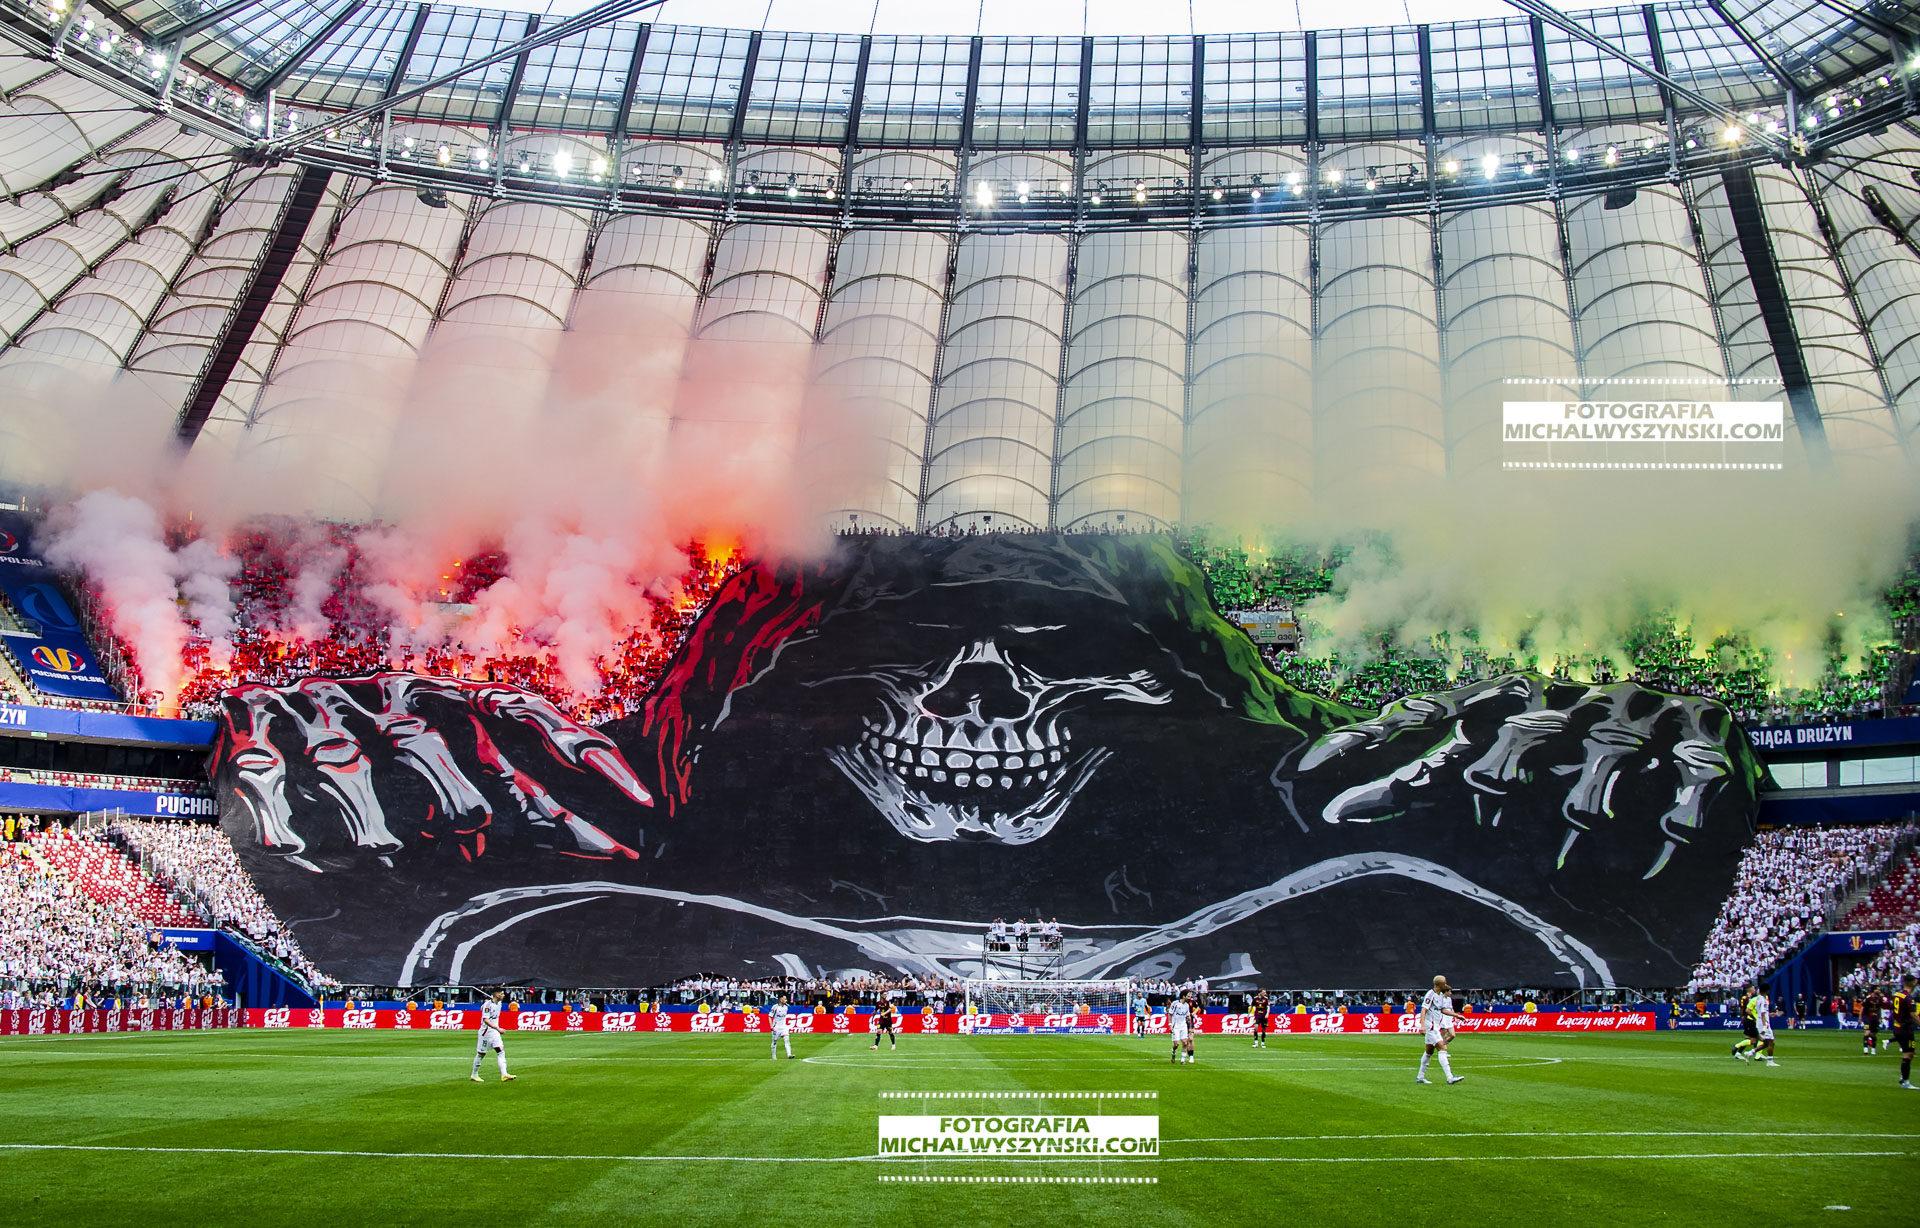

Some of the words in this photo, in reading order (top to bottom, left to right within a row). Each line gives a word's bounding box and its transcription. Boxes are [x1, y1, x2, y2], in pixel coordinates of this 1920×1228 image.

[0, 556, 43, 566] POLSKI
[30, 668, 70, 680] PUCHAR
[71, 674, 105, 684] POLSKI
[1749, 729, 1792, 748] SIĄCA
[1797, 724, 1852, 744] DRUŻYN
[29, 1010, 46, 1028] GO
[69, 1009, 85, 1027] GO
[107, 1009, 120, 1027] GO
[141, 1009, 154, 1026] GO
[172, 1009, 184, 1025] GO
[202, 1008, 213, 1025] GO
[264, 1008, 290, 1023] GO
[343, 1009, 376, 1024] GO
[430, 1010, 464, 1025] GO
[517, 1011, 551, 1026] GO
[602, 1012, 636, 1028] GO
[690, 1013, 725, 1028] GO
[786, 1013, 814, 1028] GO
[1044, 1014, 1078, 1027] GO
[1221, 1014, 1255, 1028] GO
[1310, 1014, 1344, 1028] GO
[1454, 1017, 1482, 1030] ączy
[1483, 1018, 1505, 1027] nas
[1506, 1014, 1537, 1030] piłka
[1556, 1015, 1592, 1029] Łączy
[1593, 1017, 1615, 1026] nas
[1615, 1014, 1646, 1029] piłka
